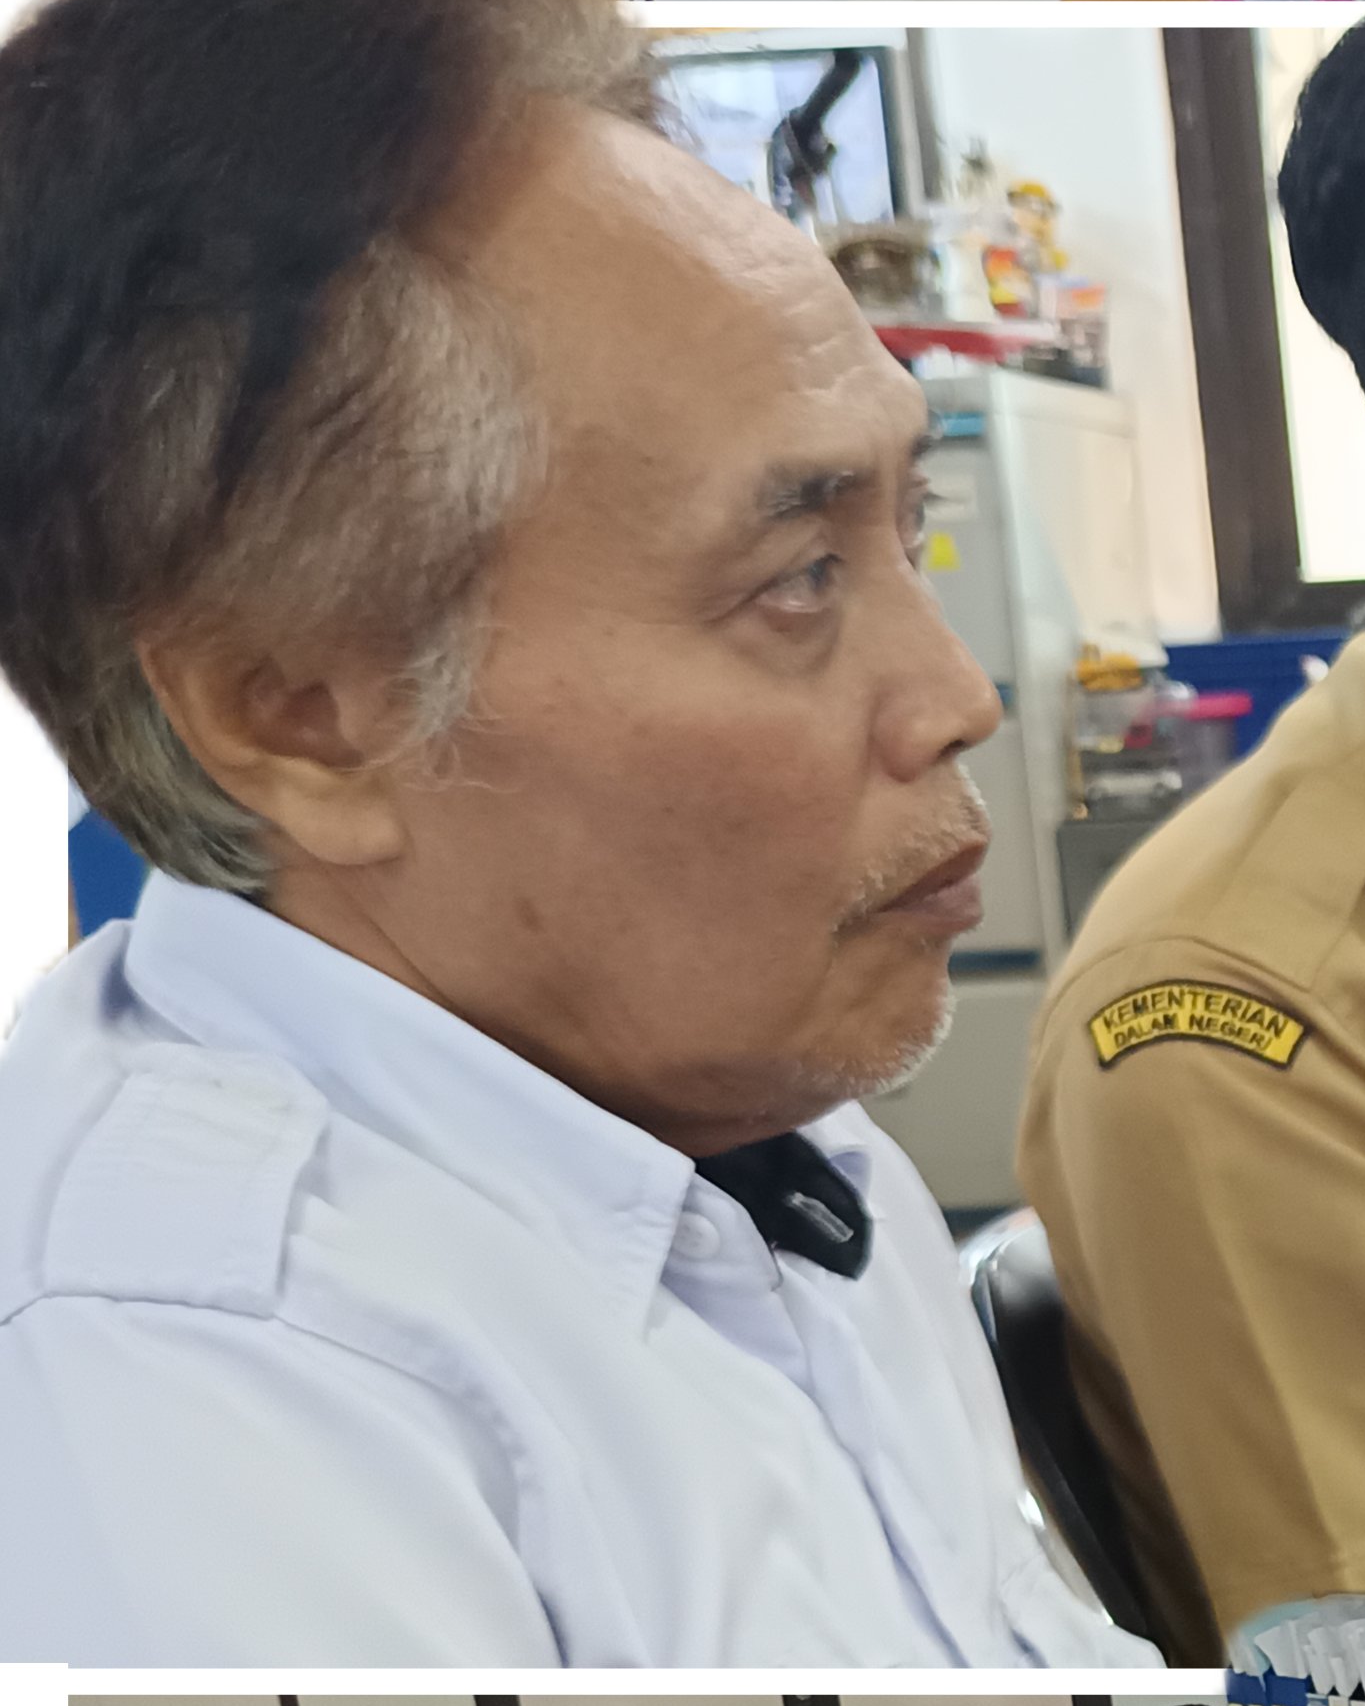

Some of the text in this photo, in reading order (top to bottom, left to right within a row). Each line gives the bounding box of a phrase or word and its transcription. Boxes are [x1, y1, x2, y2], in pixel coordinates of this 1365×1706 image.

[1101, 989, 1289, 1039] KEMENTERIAN
[1114, 1013, 1273, 1051] DALAM NEGERI
